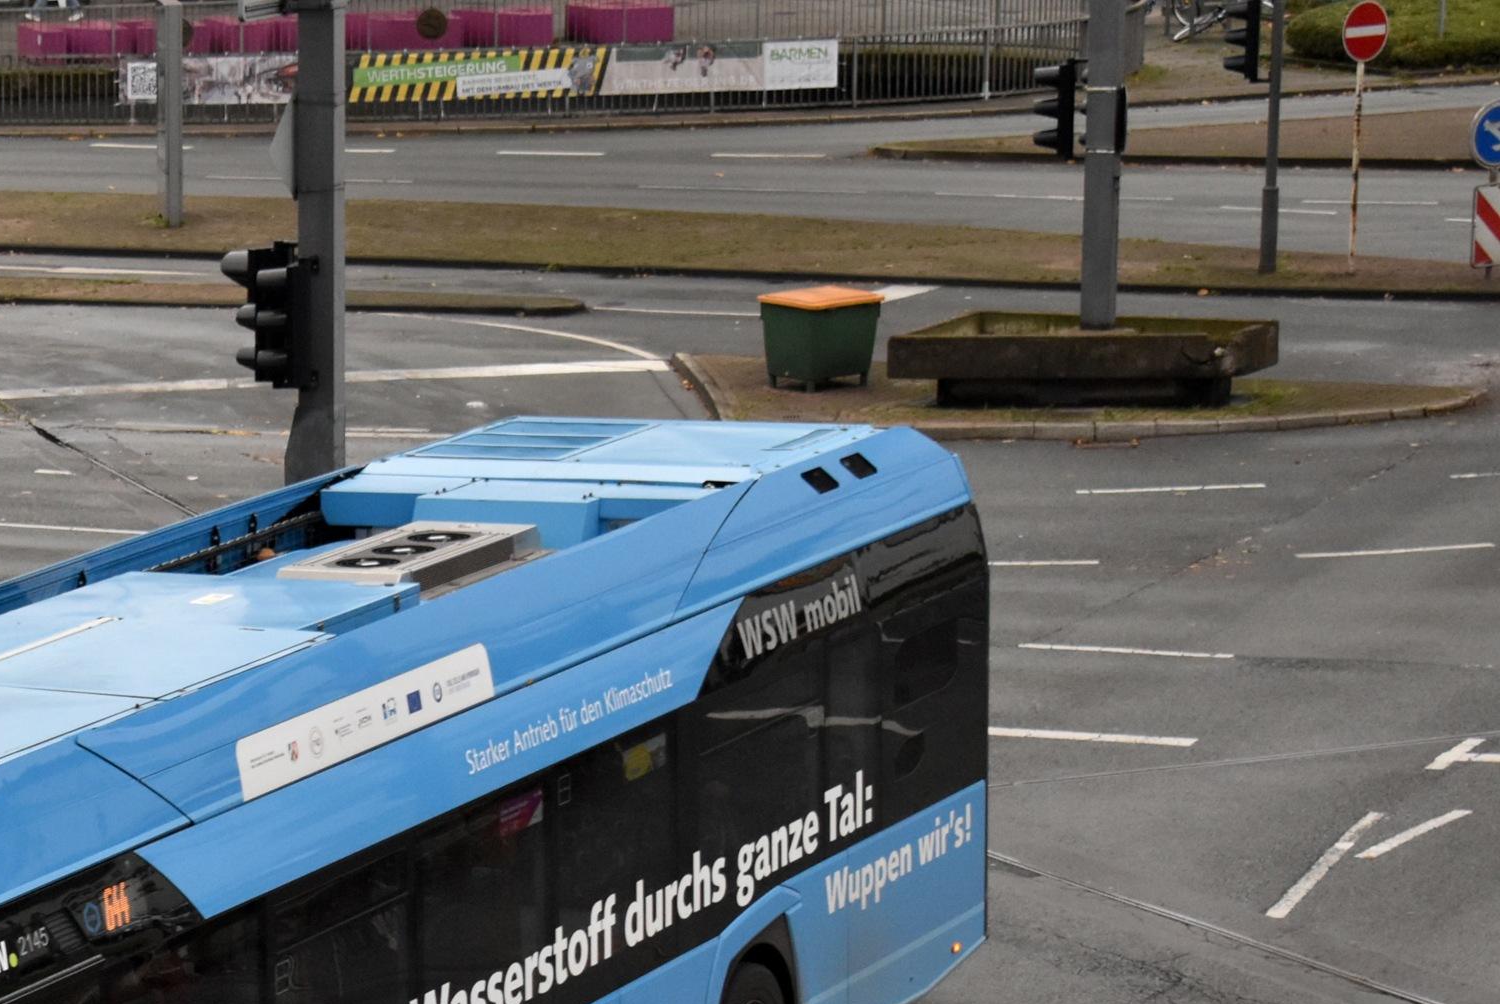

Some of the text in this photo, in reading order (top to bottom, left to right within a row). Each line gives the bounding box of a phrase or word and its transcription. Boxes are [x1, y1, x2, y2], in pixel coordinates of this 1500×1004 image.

[366, 60, 508, 83] WERTHSTEIGERUNG
[736, 573, 862, 660] WSW mobil
[465, 667, 674, 776] Starker Antrieb für den Klimaschutz
[624, 849, 728, 948] durchs
[735, 807, 819, 907] ganze
[823, 769, 874, 842] Tal:
[824, 802, 972, 915] Wuppen wir's!
[17, 926, 50, 957] 2145
